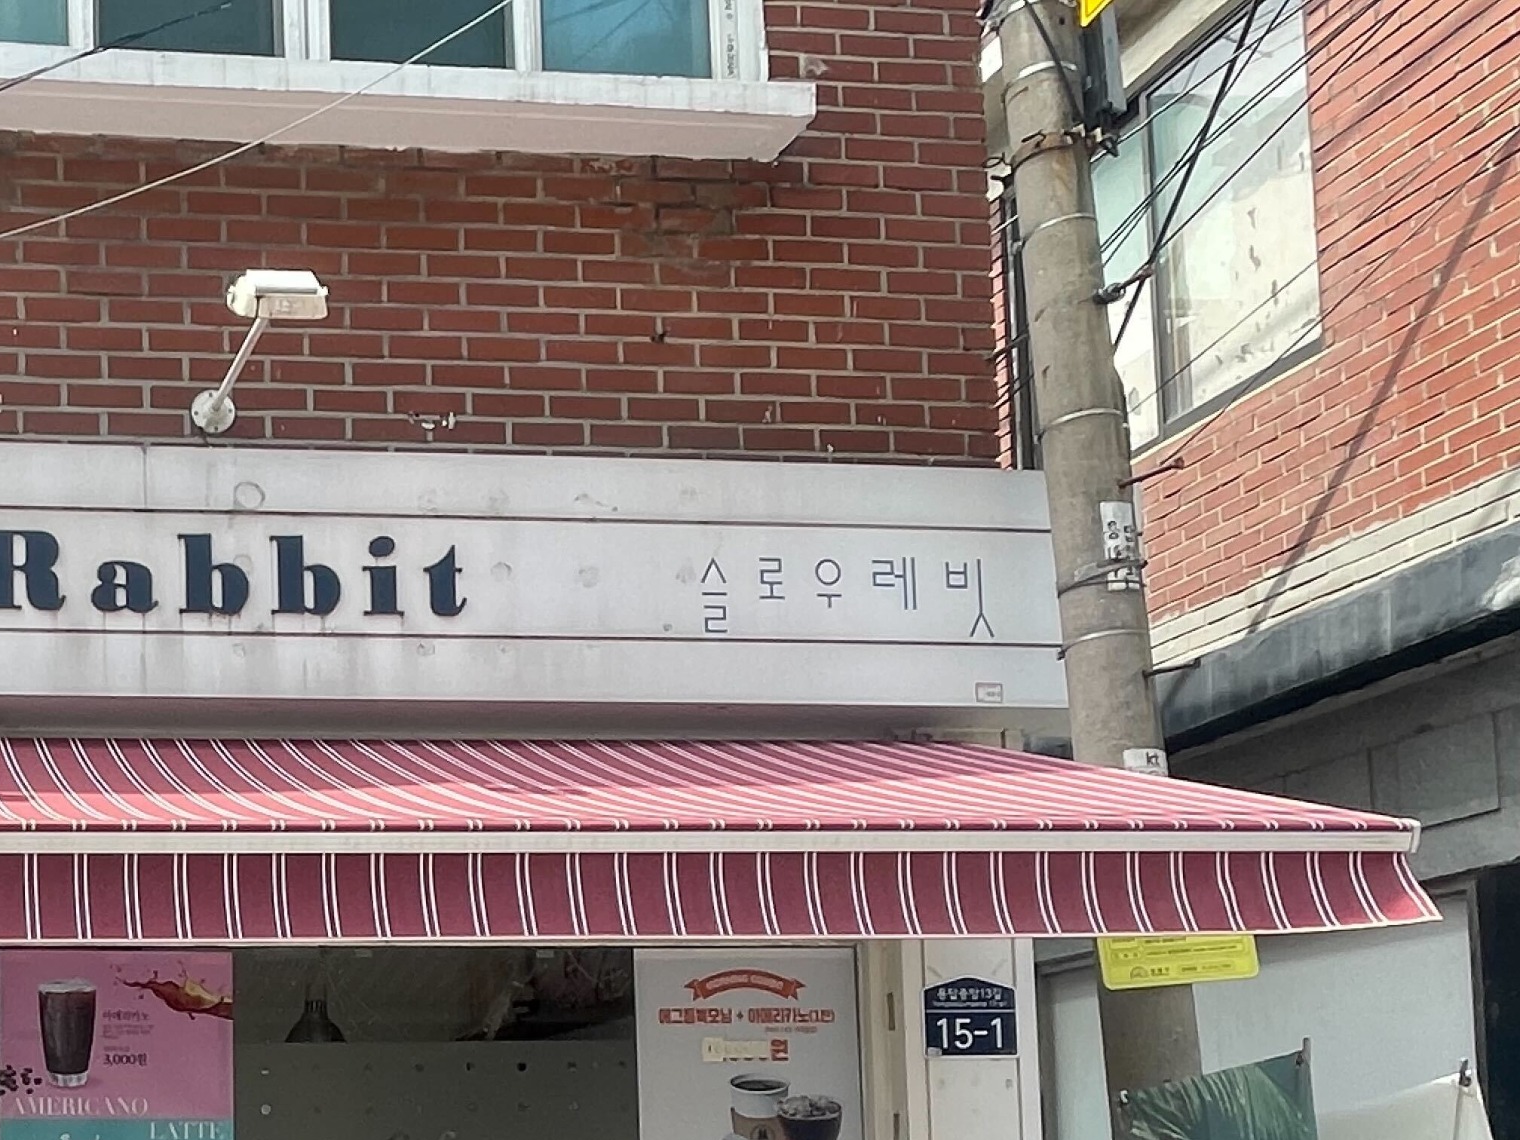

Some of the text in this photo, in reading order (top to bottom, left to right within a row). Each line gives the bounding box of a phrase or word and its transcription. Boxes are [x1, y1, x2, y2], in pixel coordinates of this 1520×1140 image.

[701, 555, 996, 638] 슬로우레빗
[936, 1018, 1003, 1049] 15-1
[15, 1096, 148, 1116] AMERICANO
[150, 1121, 226, 1140] LATTE
